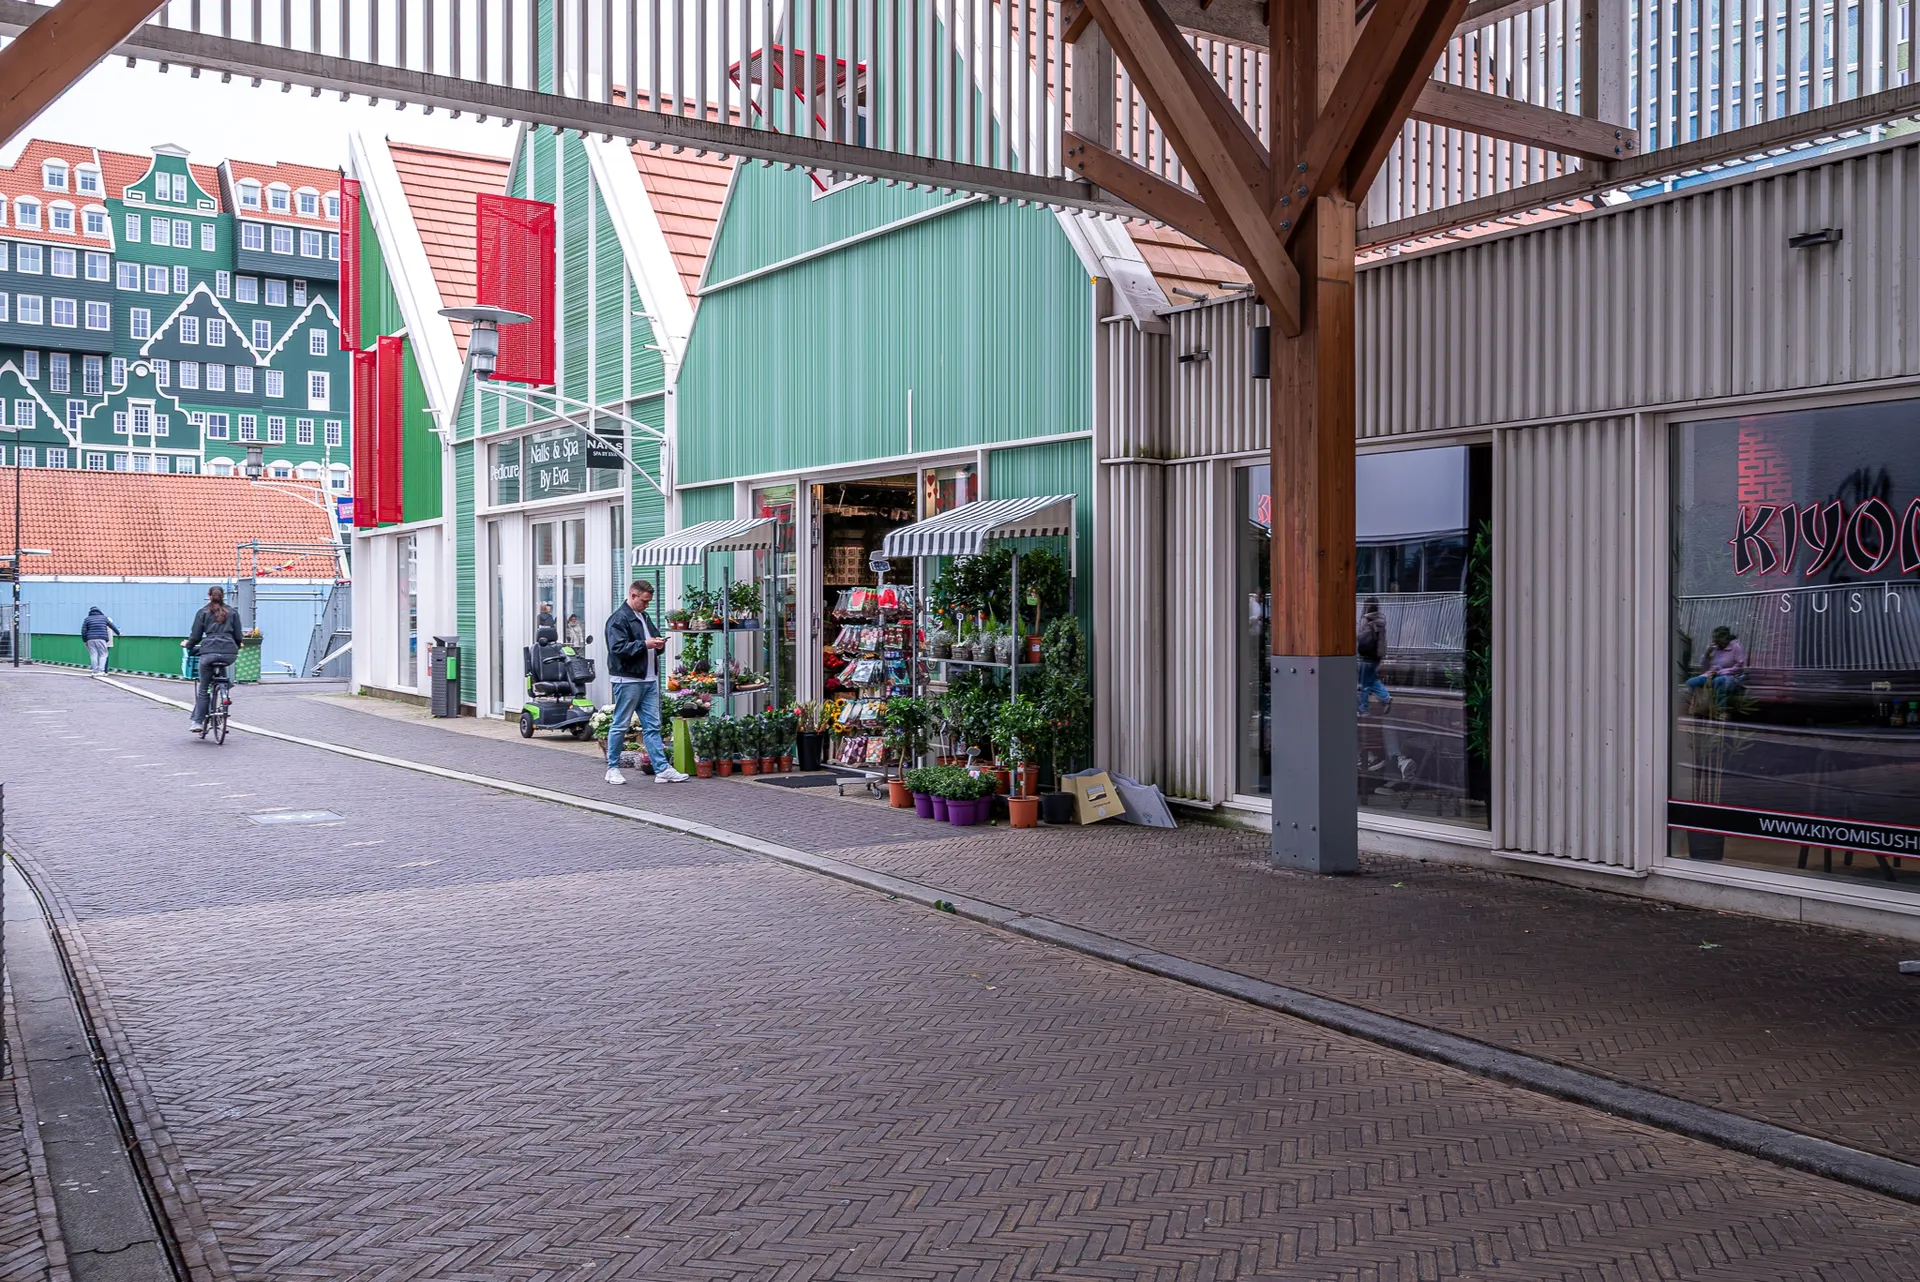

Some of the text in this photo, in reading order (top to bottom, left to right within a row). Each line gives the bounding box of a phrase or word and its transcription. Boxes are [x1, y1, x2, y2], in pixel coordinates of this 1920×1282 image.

[530, 438, 579, 463] Nails & Spa
[490, 464, 520, 480] Pedicure
[540, 466, 569, 491] By Eva
